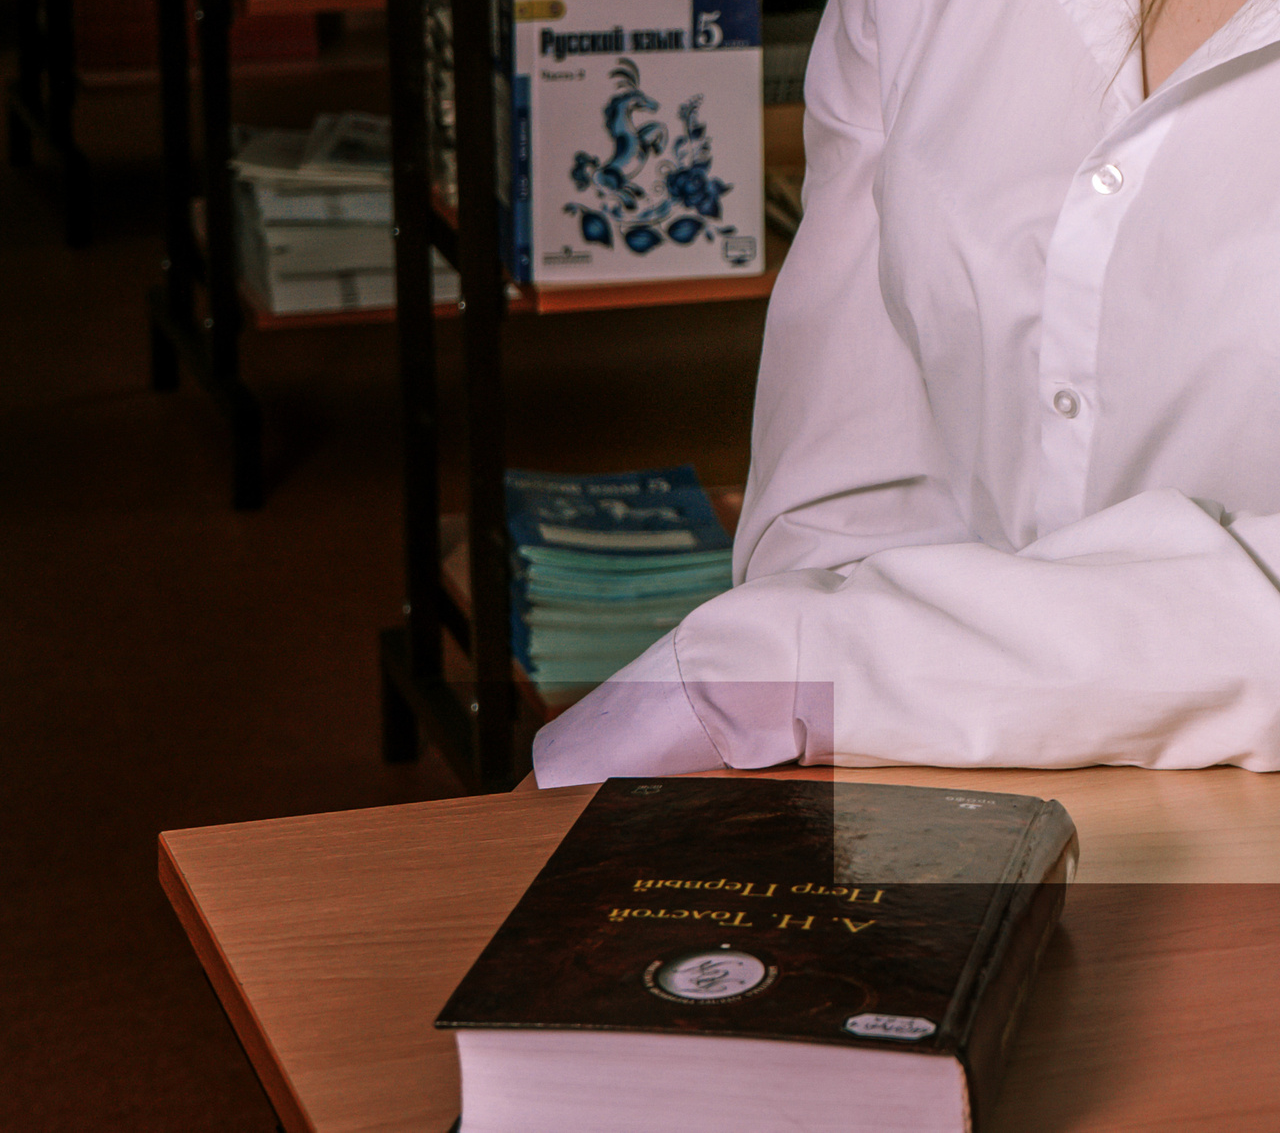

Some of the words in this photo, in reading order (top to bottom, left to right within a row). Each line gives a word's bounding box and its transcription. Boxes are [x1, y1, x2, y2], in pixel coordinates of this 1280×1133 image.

[540, 26, 624, 63] Русский
[631, 28, 685, 51] язык
[695, 9, 724, 50] 5
[633, 878, 778, 900] Первый
[792, 884, 887, 906] Петр
[609, 905, 752, 928] Толстой
